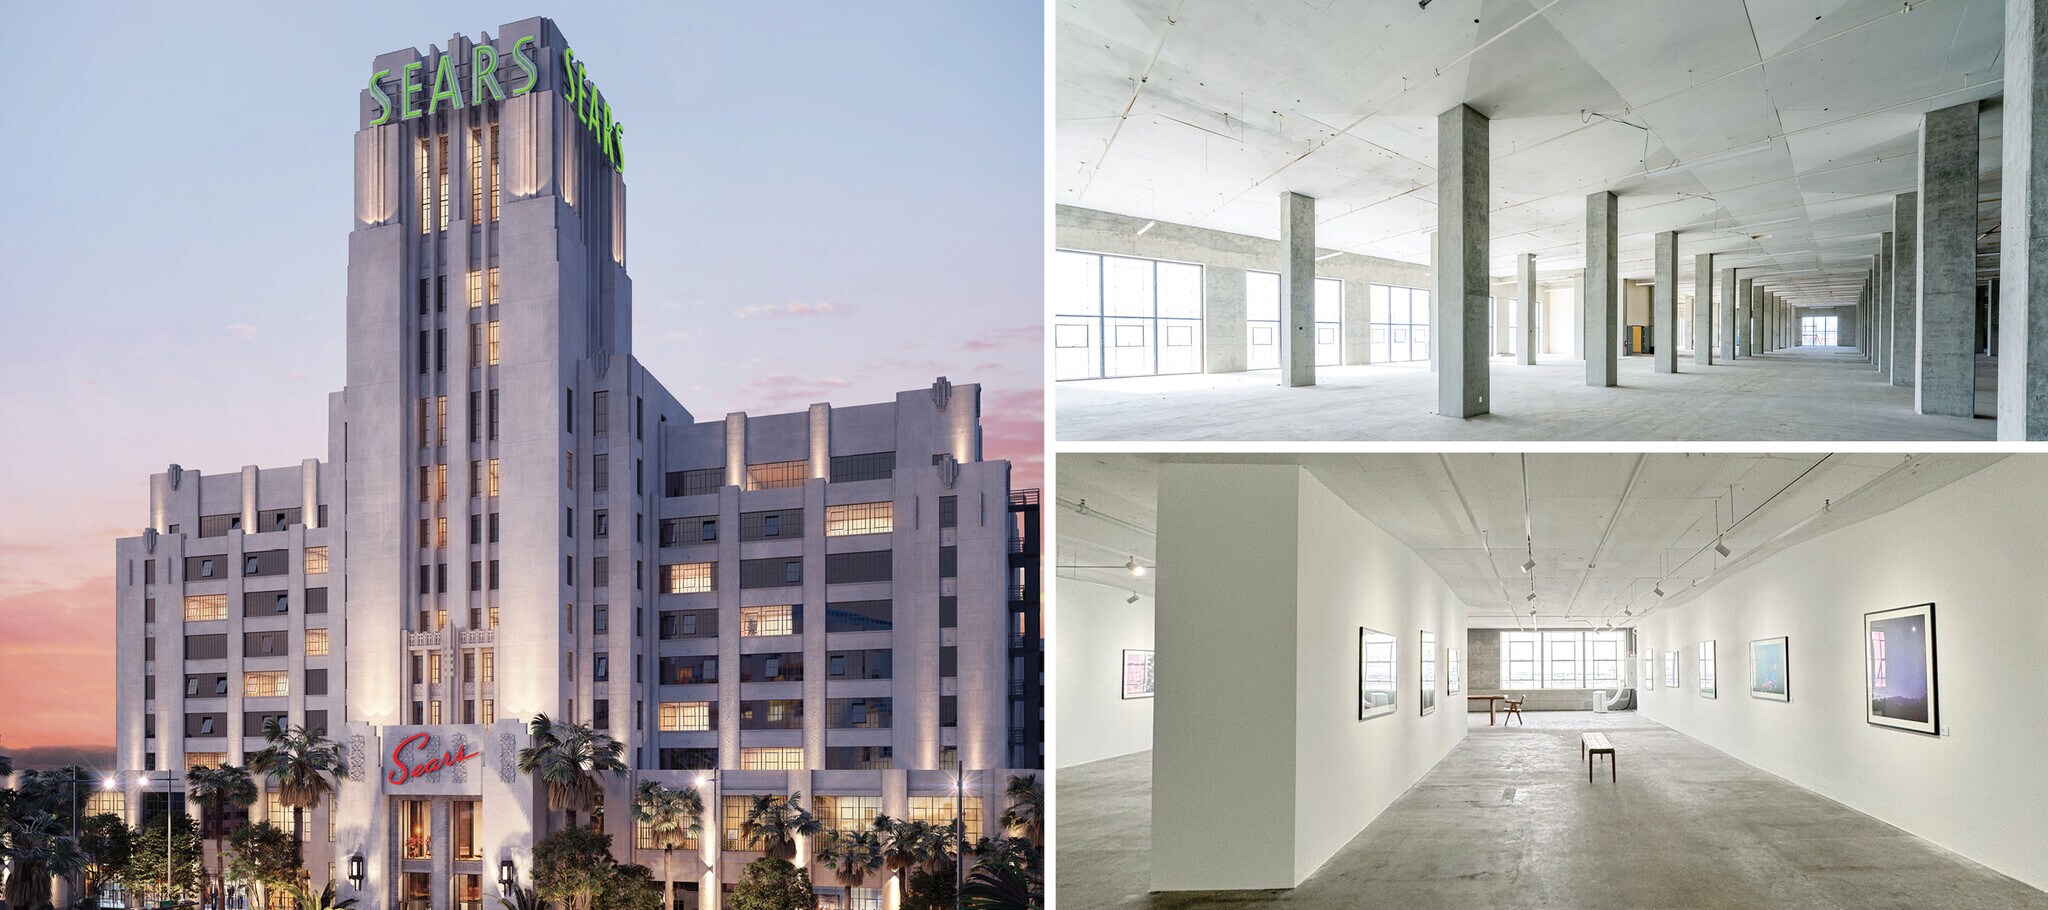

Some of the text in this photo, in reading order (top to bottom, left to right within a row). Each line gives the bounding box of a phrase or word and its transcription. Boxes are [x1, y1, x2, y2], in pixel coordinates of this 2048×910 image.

[369, 35, 538, 127] SEARS
[563, 46, 625, 174] SEARS
[388, 733, 479, 785] Sears
